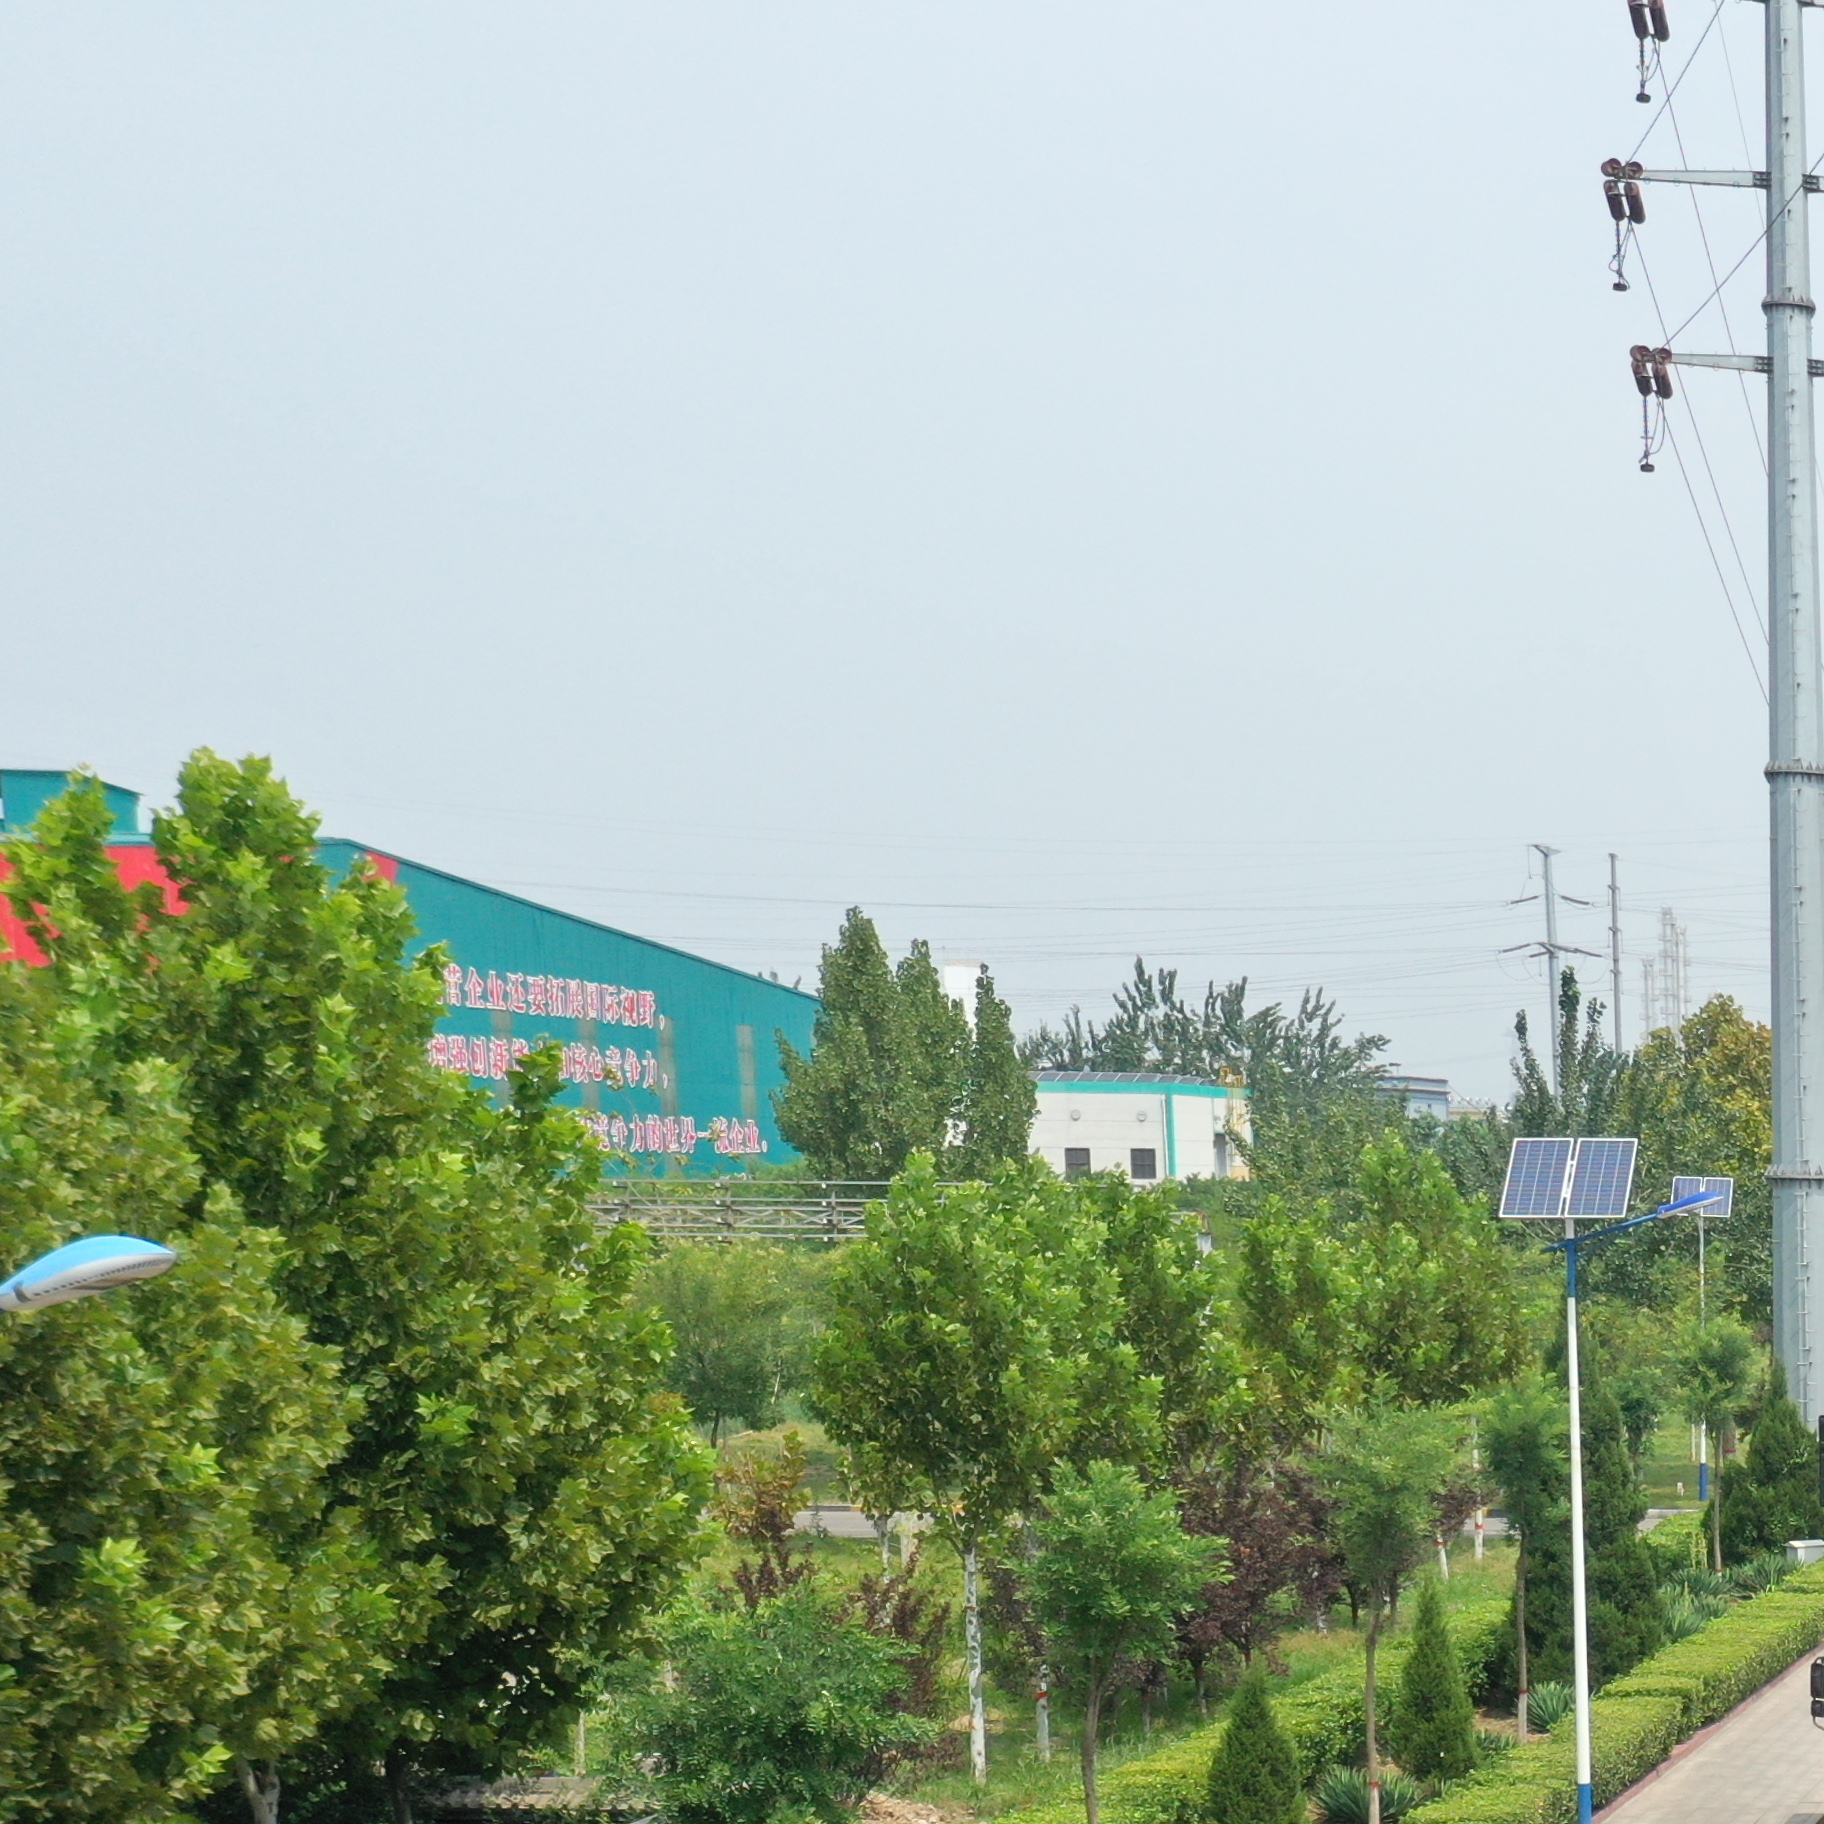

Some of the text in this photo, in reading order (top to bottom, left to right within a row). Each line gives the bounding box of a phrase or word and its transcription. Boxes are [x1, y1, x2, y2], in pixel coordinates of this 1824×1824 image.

[436, 963, 666, 1031] 营企业还要拓展国际视野，
